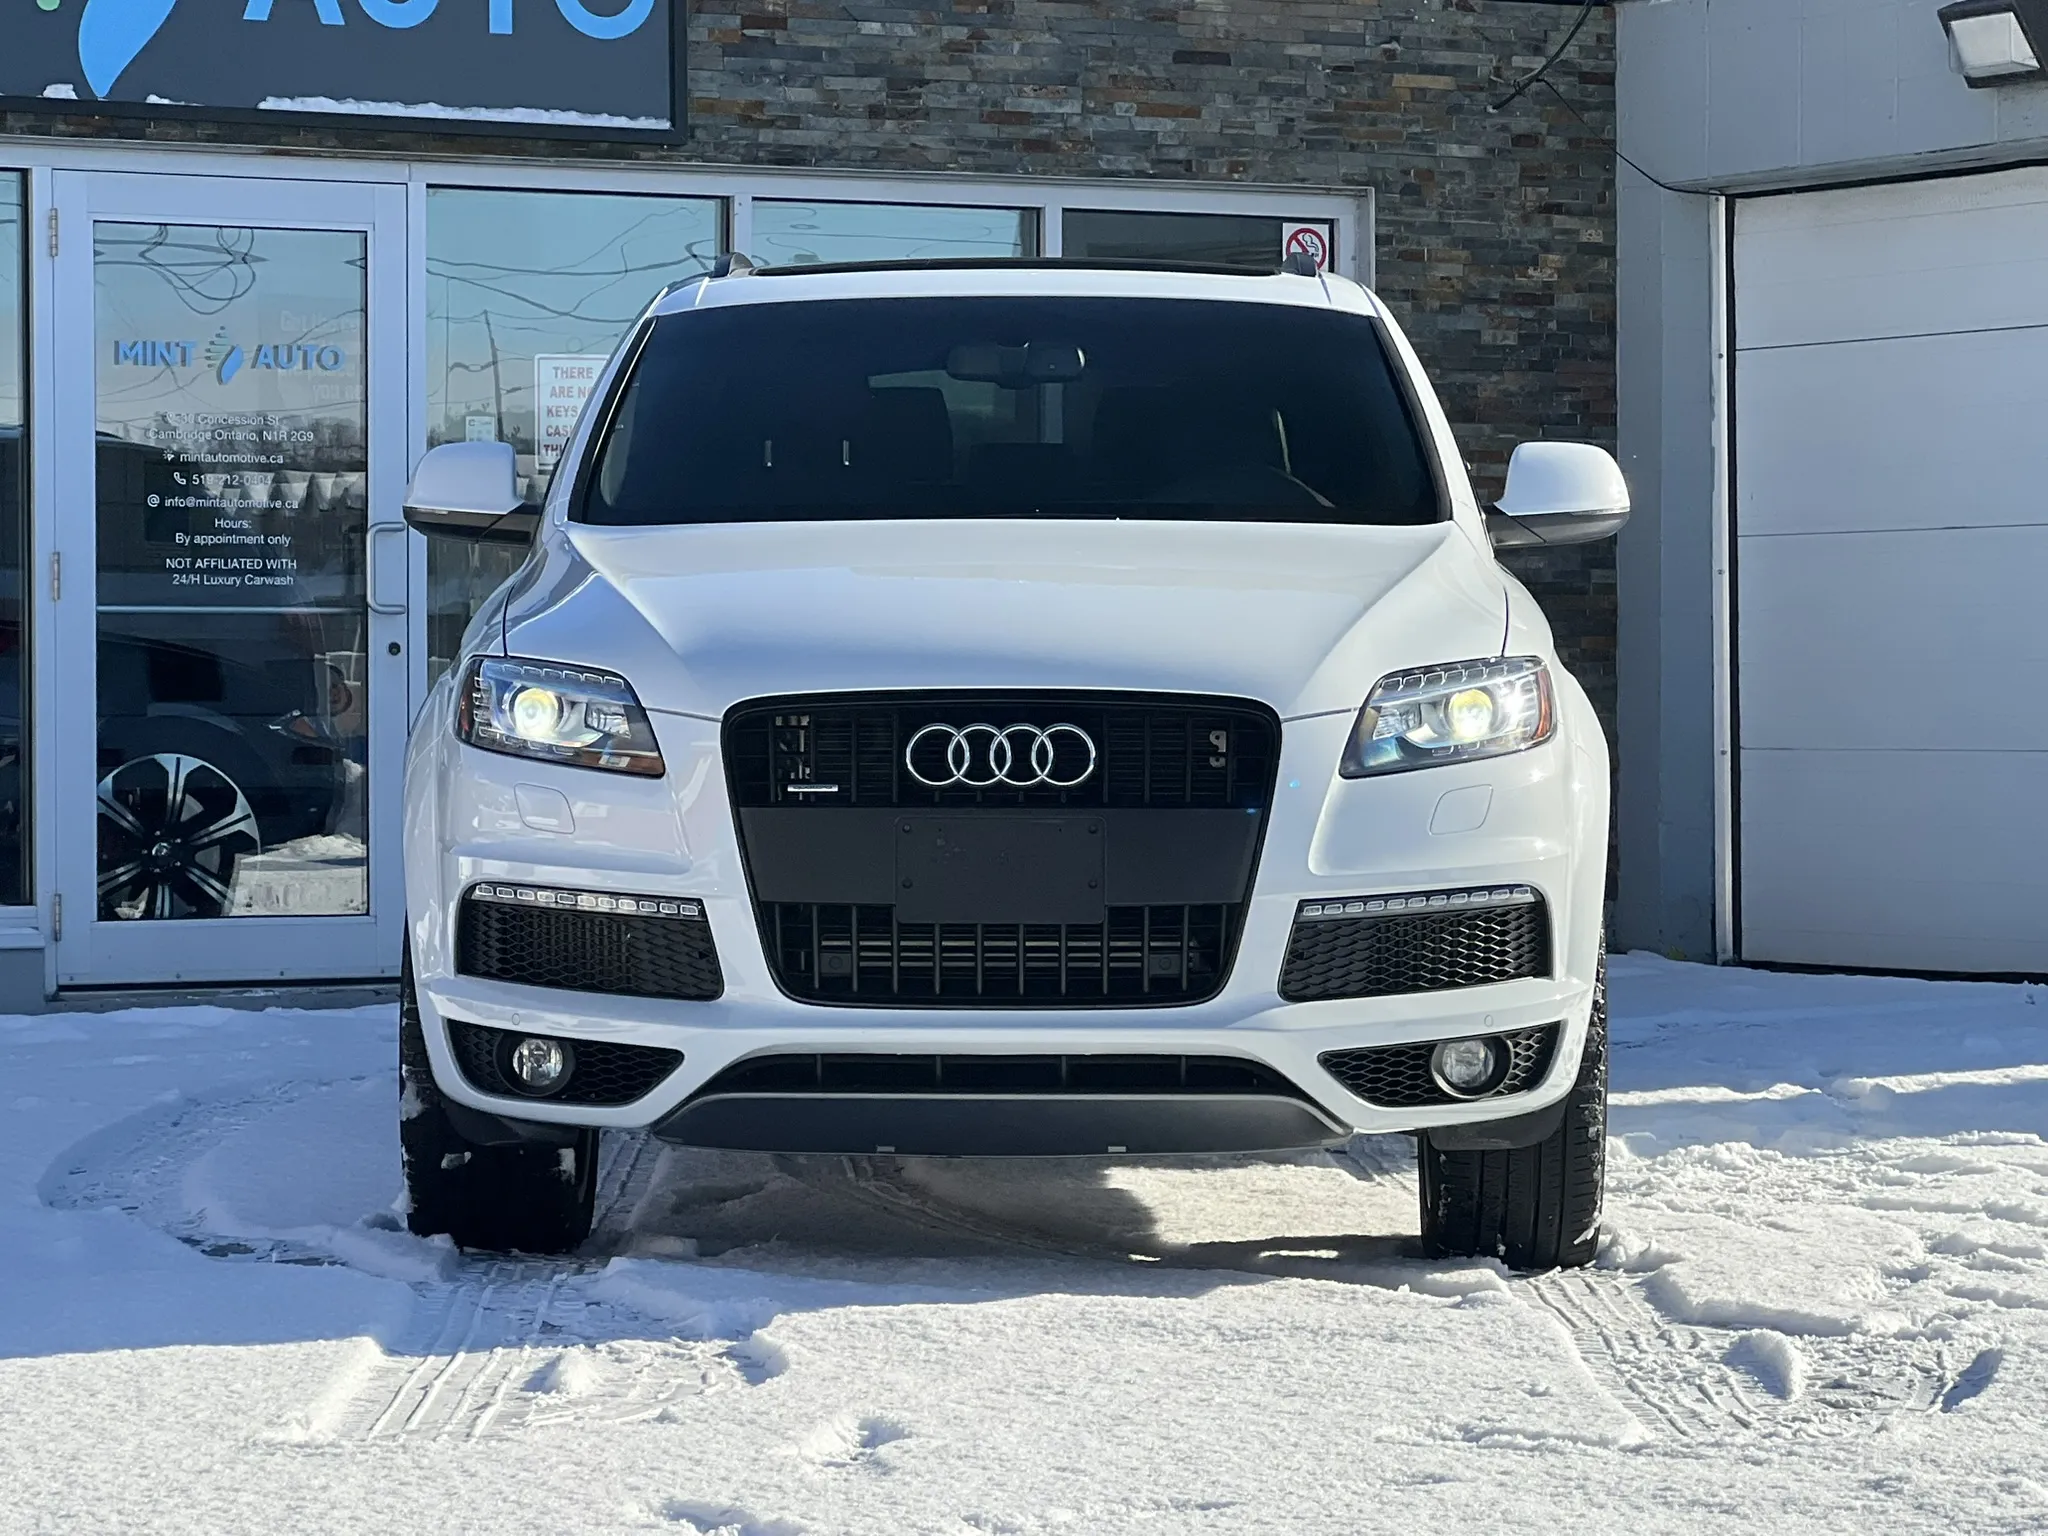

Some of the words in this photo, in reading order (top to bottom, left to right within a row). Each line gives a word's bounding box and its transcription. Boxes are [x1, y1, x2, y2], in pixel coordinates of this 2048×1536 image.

[113, 340, 197, 368] MINT
[250, 343, 346, 371] AUTO
[552, 366, 593, 379] THERE
[550, 386, 574, 398] ARE
[546, 405, 578, 417] KEYS
[198, 413, 264, 426] Concession
[267, 415, 279, 425] St
[149, 428, 212, 442] Cambridge
[214, 430, 260, 443] Ontario,
[262, 431, 287, 442] N1R
[290, 431, 314, 442] 2G9
[180, 452, 284, 464] mintautomotive.ca
[164, 496, 299, 509] info@mintautomotive.ca
[214, 518, 252, 529] Hours:
[175, 533, 191, 546] By
[193, 534, 265, 546] appointment
[267, 534, 292, 547] only
[166, 558, 192, 569] NOT
[194, 558, 263, 570] AFFILIATED
[266, 559, 297, 570] WITH
[172, 574, 200, 585] 24/H
[203, 574, 242, 588] Luxury
[244, 575, 294, 586] Carwash
